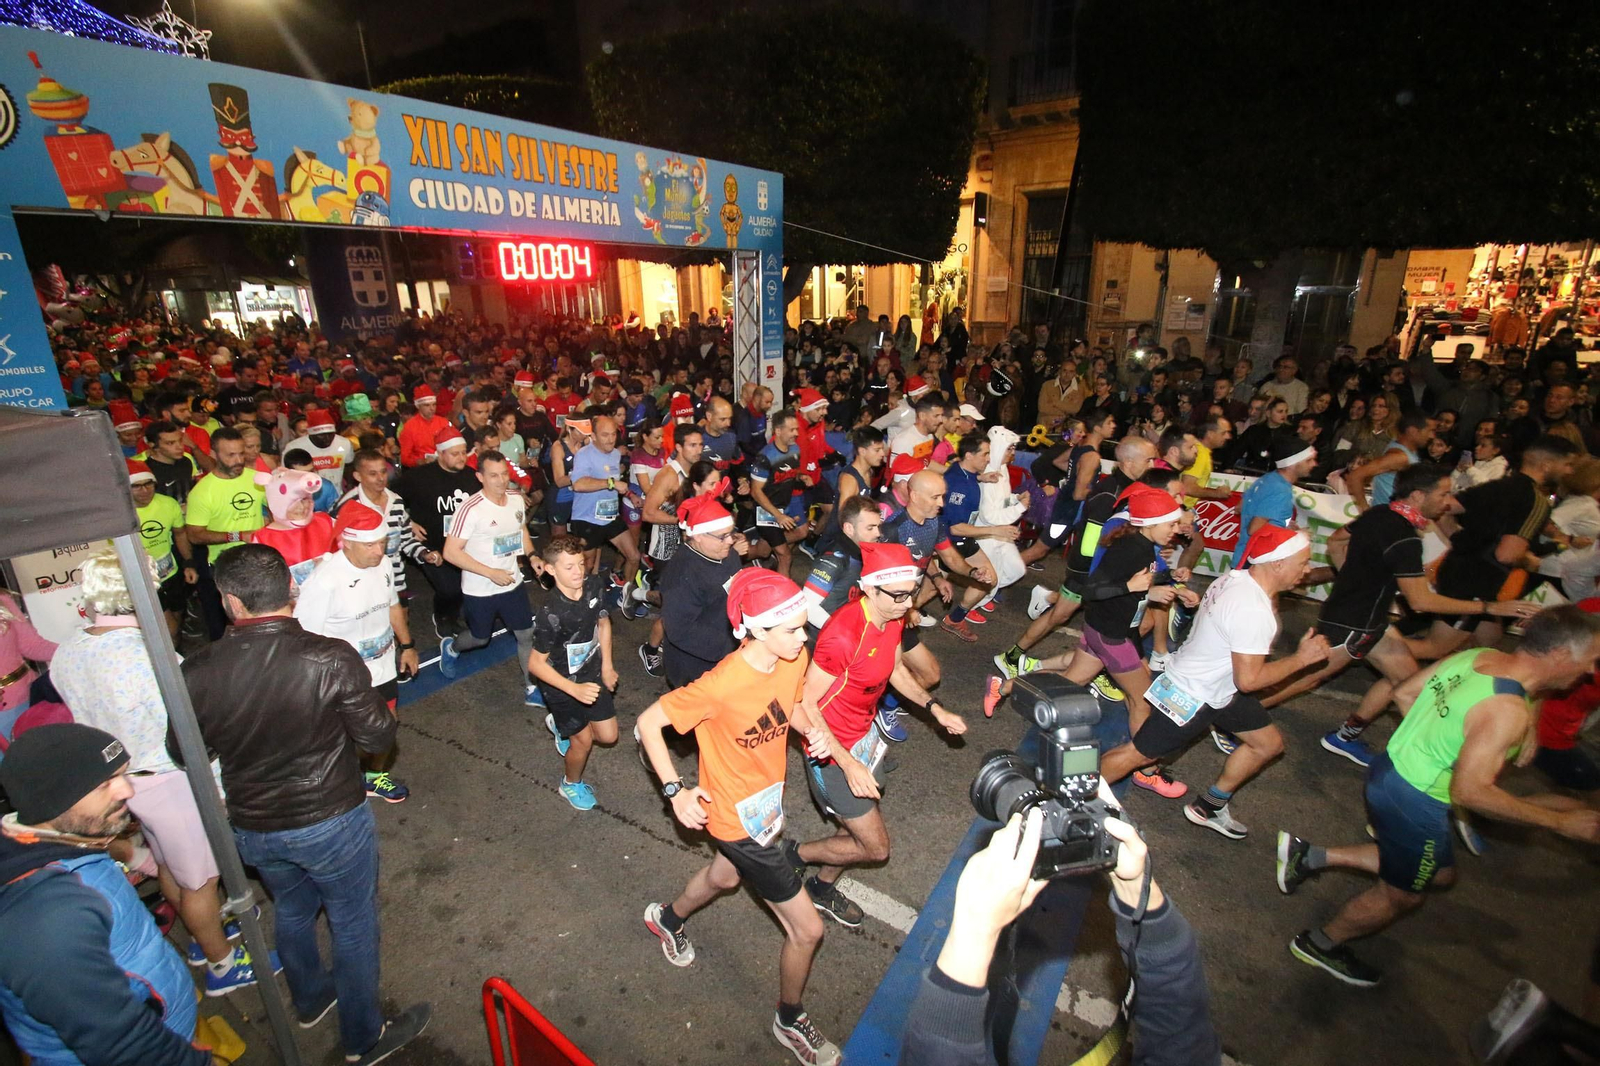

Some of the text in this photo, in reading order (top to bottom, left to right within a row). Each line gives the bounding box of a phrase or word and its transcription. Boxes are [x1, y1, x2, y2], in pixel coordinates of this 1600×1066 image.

[401, 113, 619, 194] XII SAN SILVESTRE
[409, 178, 622, 226] CIUDAD DE ALMERÍA
[747, 215, 777, 228] ALMERÍA
[753, 228, 773, 236] CIUDAD
[0, 387, 33, 397] RUPO
[28, 397, 55, 408] CAR
[1170, 692, 1193, 711] 895
[735, 725, 788, 749] adida
[760, 795, 780, 818] 1665
